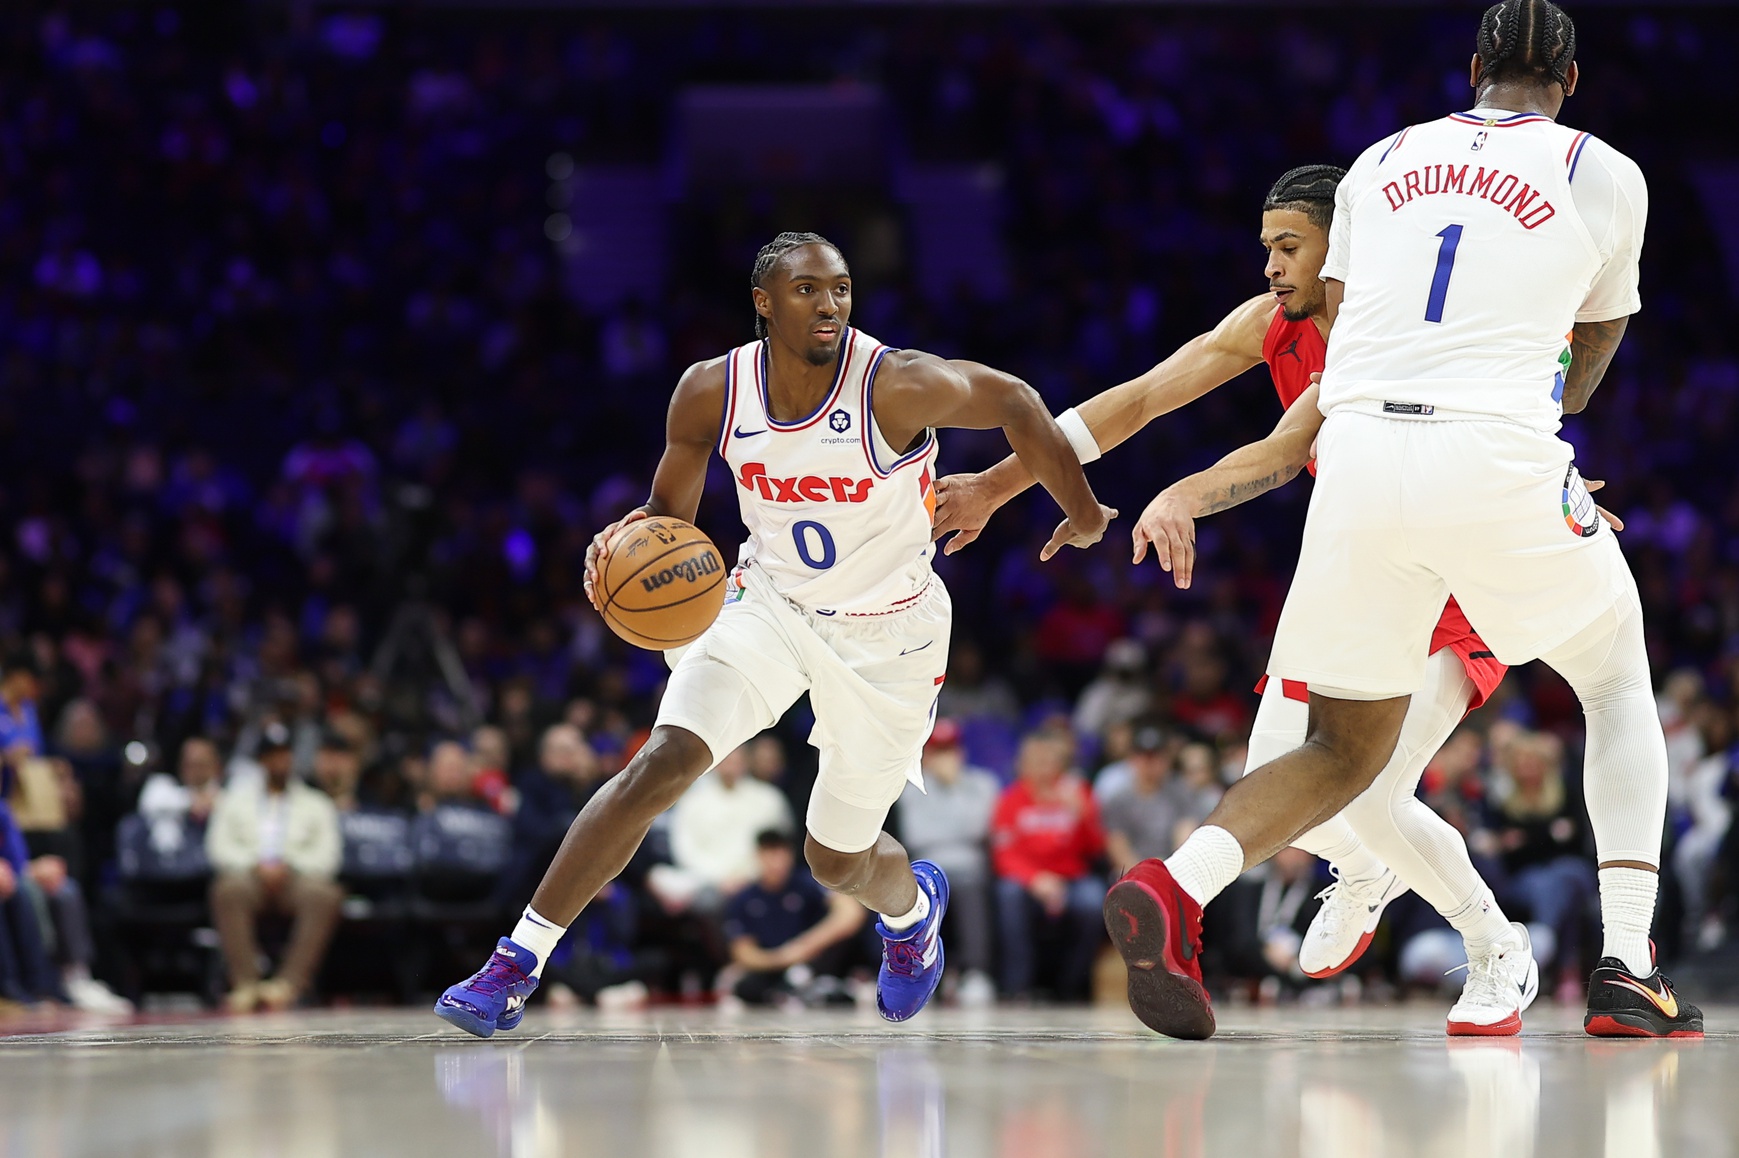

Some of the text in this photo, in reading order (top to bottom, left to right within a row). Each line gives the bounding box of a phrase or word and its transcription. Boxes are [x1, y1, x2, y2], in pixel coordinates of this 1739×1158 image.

[1382, 164, 1555, 230] DRUMMOND
[1424, 223, 1464, 323] 1
[738, 462, 874, 503] Sixers
[791, 520, 836, 570] 0
[640, 550, 721, 593] Wilson
